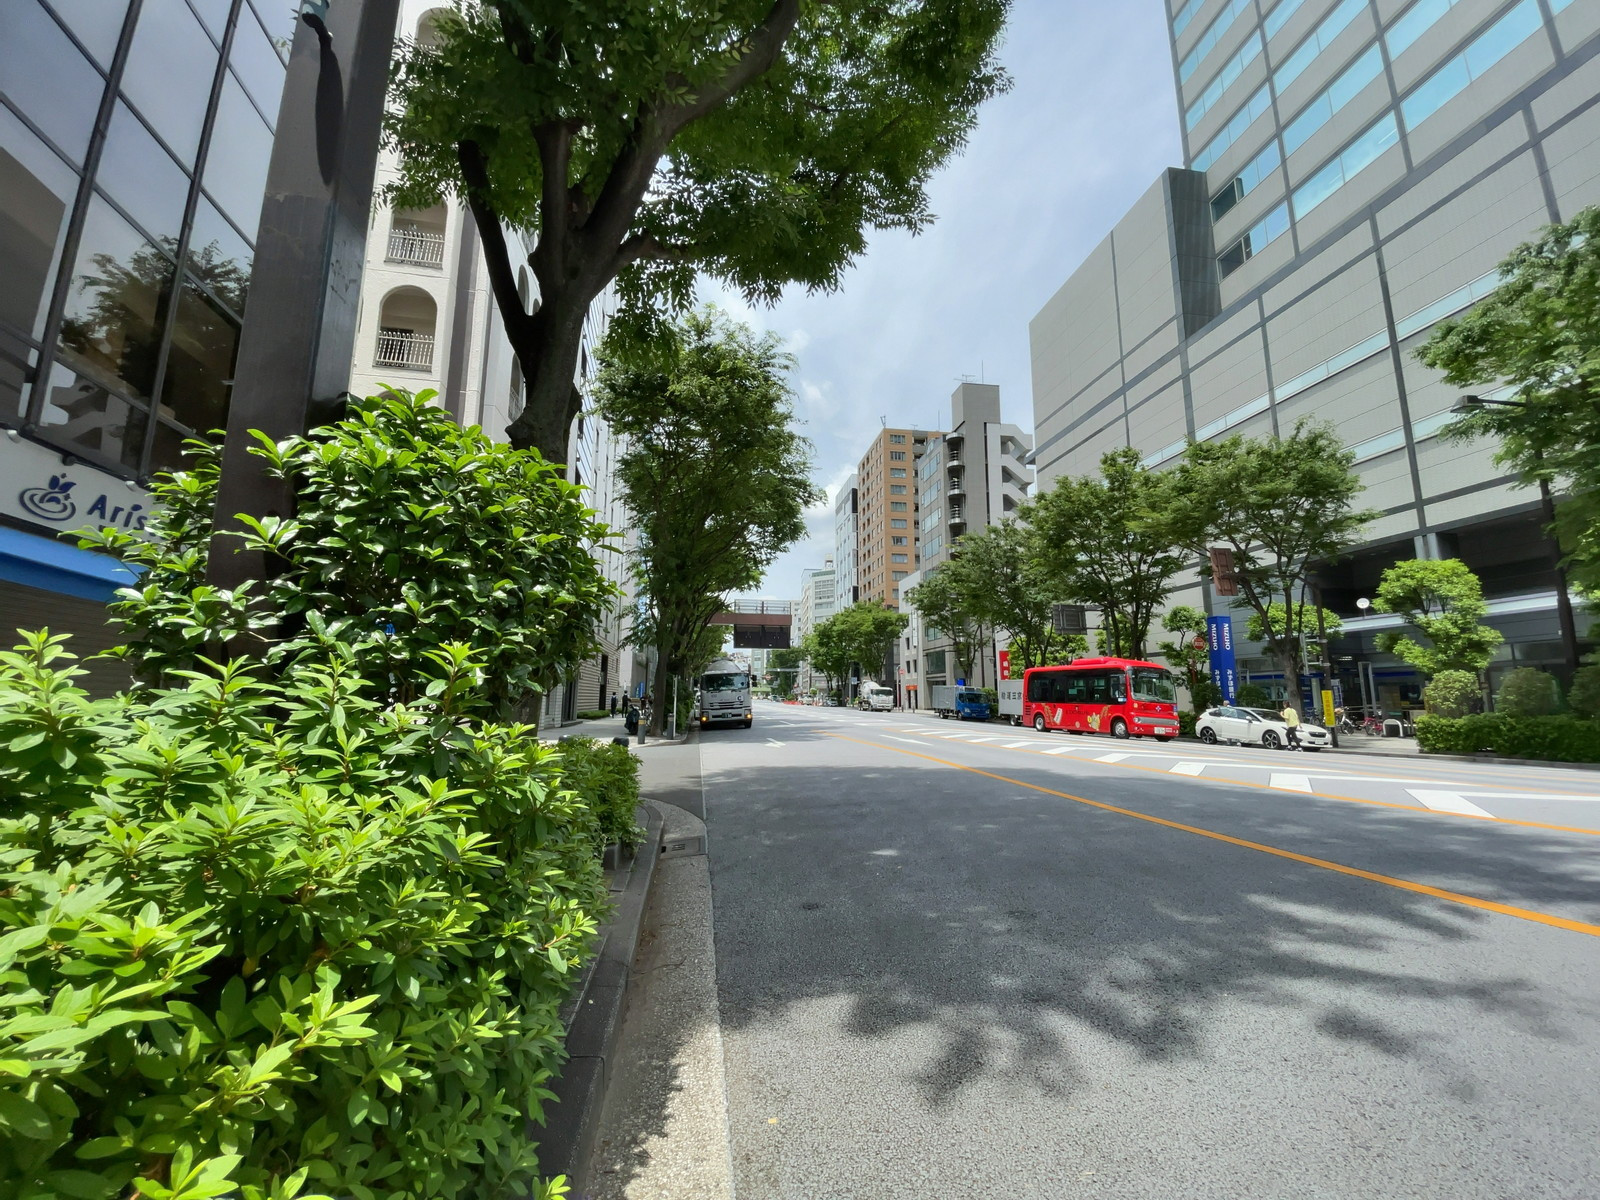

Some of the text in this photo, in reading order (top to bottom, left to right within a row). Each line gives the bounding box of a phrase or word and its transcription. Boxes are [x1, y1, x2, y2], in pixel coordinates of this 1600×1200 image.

[1223, 623, 1231, 651] MIZUHO
[1226, 669, 1235, 699] みずほ銀行
